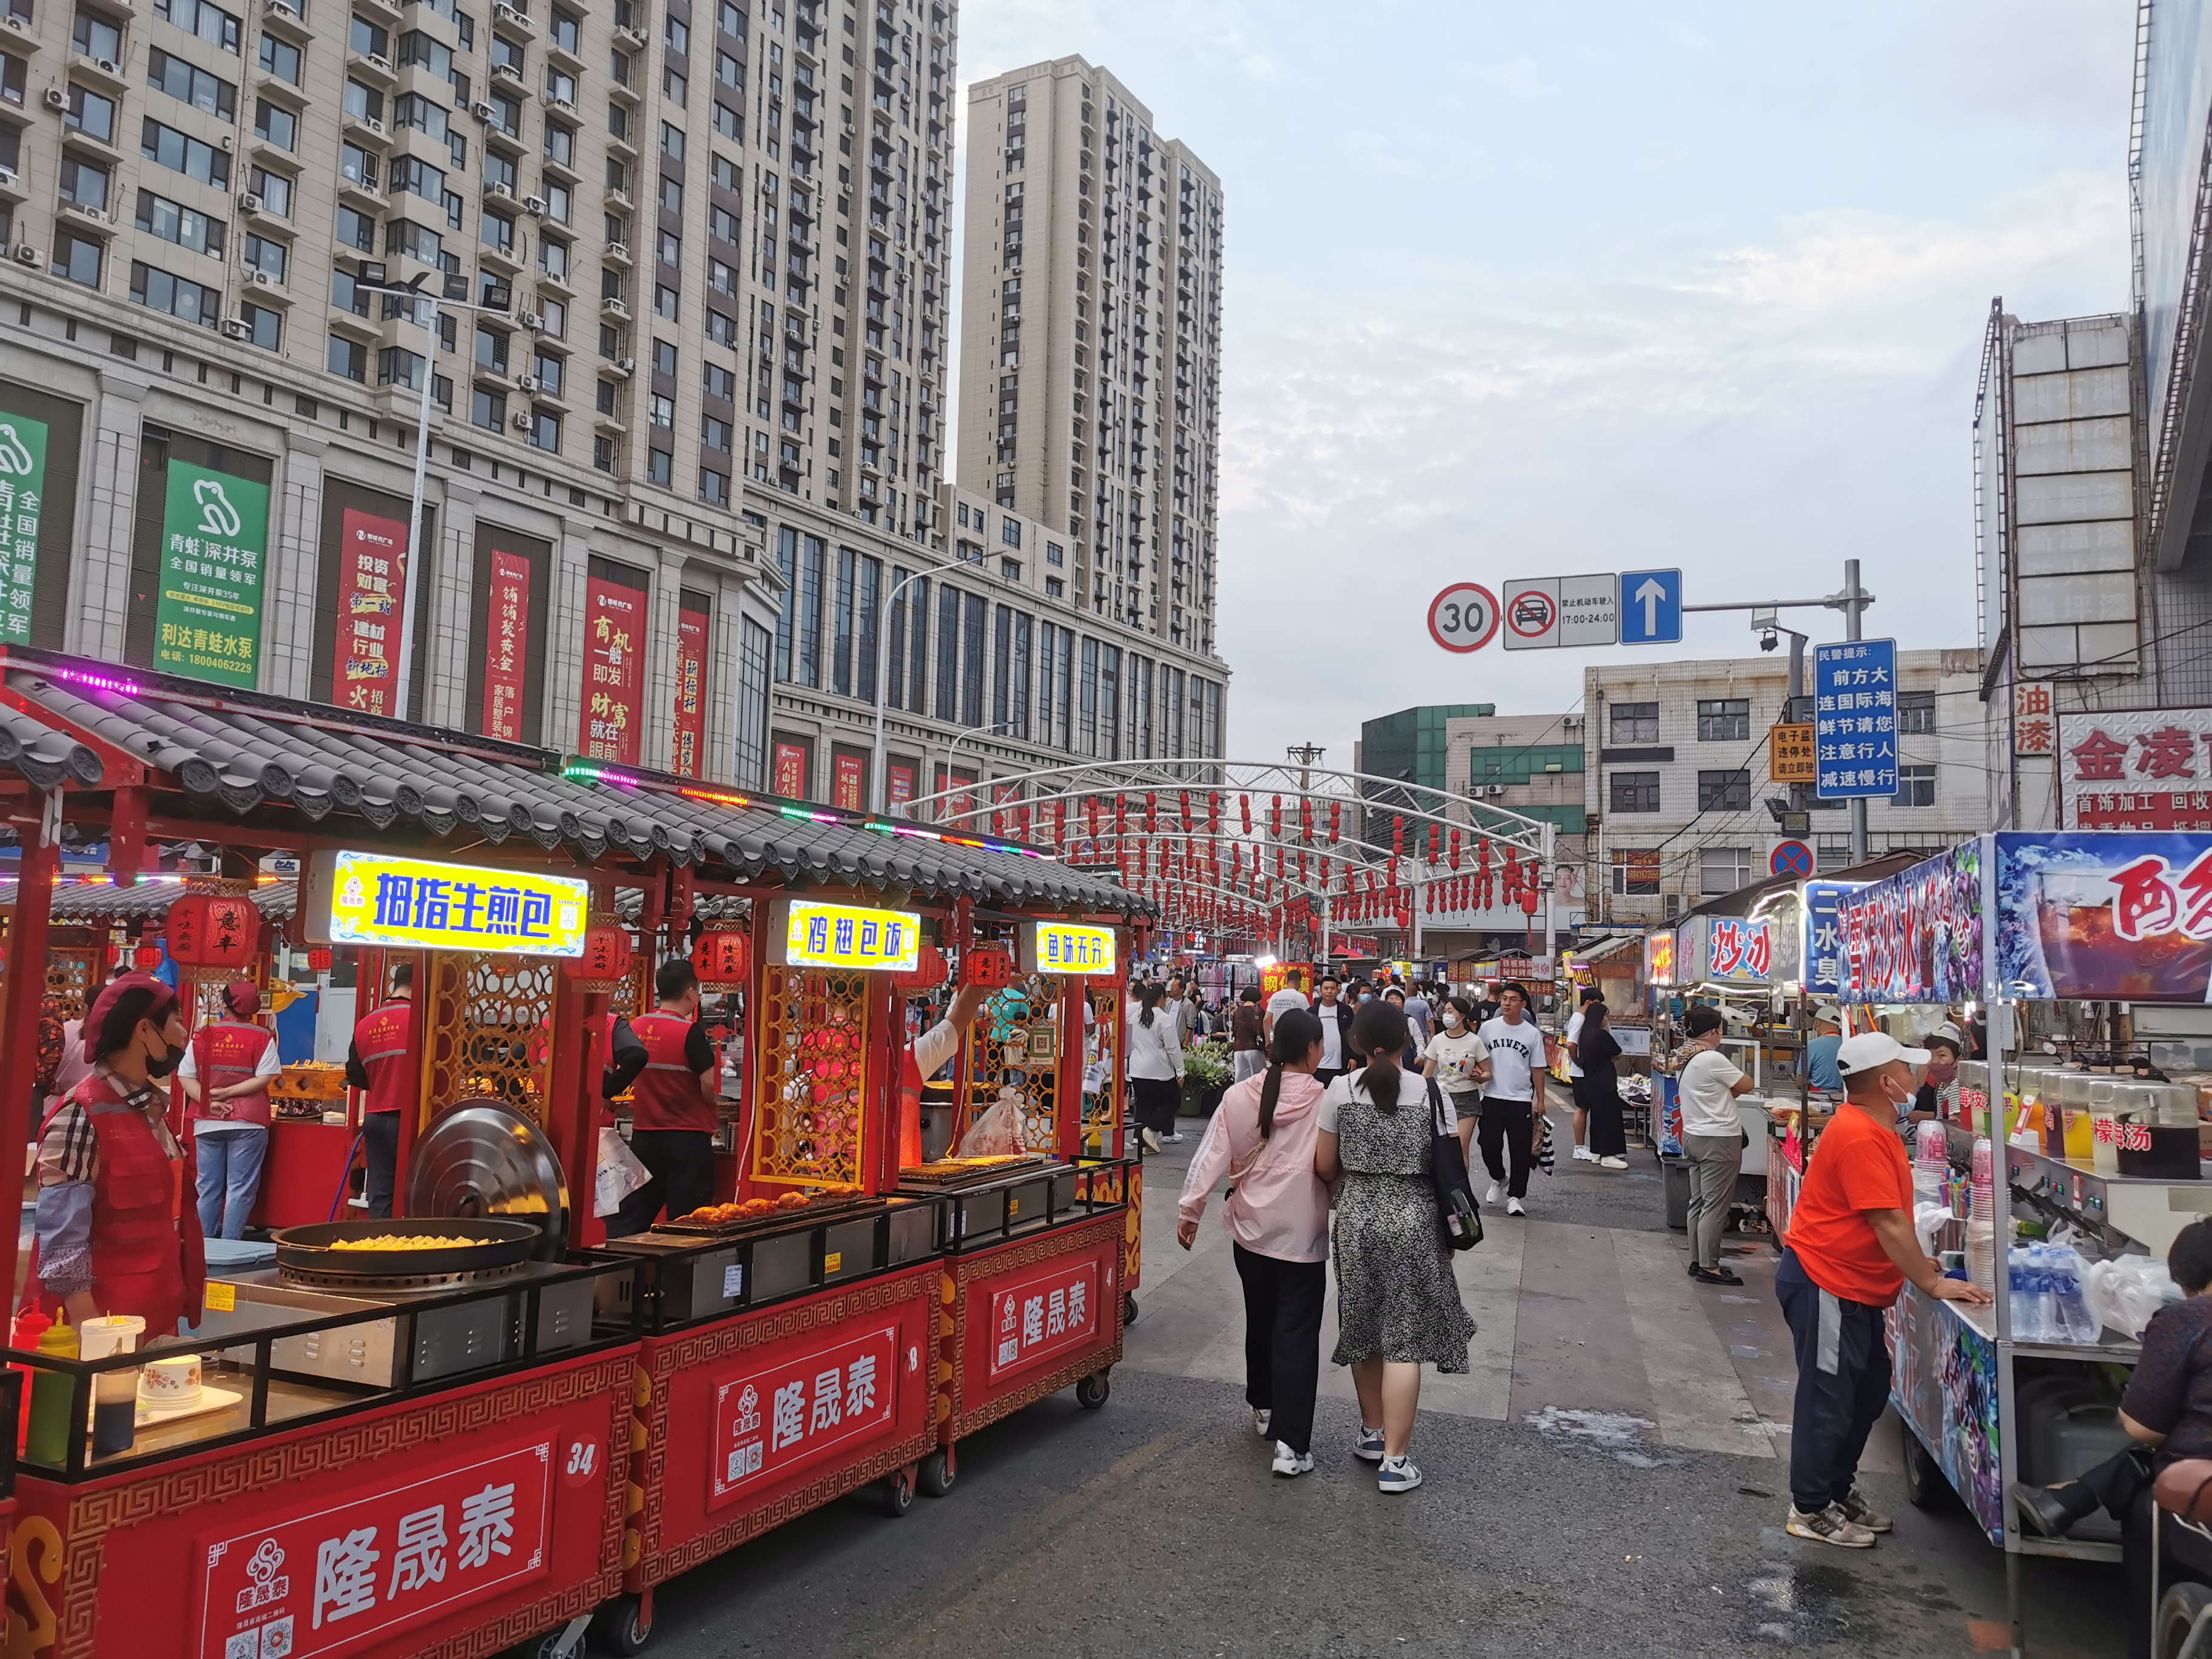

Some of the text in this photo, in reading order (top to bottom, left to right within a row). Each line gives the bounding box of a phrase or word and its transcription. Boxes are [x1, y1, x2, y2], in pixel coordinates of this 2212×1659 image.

[7, 489, 40, 635] 全国销量领军
[170, 556, 256, 586] 全国销量领军
[357, 554, 389, 576] 投资
[183, 581, 240, 600] 专注深井泵35年
[357, 572, 389, 594] 财富
[350, 591, 392, 615] 第一站
[1561, 596, 1615, 608] 禁止机动车驶入
[354, 620, 386, 640] 建材
[498, 585, 519, 673] 铺铺聚黄金
[1443, 602, 1484, 634] 30
[161, 623, 253, 659] 利达青蛙水泵
[593, 615, 633, 653] 商机
[352, 638, 384, 659] 行业
[594, 645, 623, 665] 一触
[189, 654, 252, 674] 18004062229
[345, 655, 389, 679] 新地标
[592, 663, 622, 687] 即发
[1832, 666, 1889, 686] 前方大
[685, 659, 698, 715] 新标杆
[370, 688, 384, 715] 招商
[590, 691, 629, 730] 财富
[1818, 690, 1892, 712] 连国际海
[589, 718, 619, 741] 就在
[1818, 715, 1894, 736] 鲜节请您
[2016, 685, 2053, 752] 油漆
[1778, 730, 1815, 743] 电子监
[588, 740, 618, 762] 眼前
[1820, 741, 1894, 761] 注意行人
[2070, 725, 2212, 780] 金凌
[782, 760, 791, 799] 人山人
[1821, 768, 1895, 788] 减速慢行
[2078, 791, 2211, 814] 首饰加工 回收
[374, 872, 552, 939] 拇指生煎包
[807, 916, 902, 957] 鸡翅包饭
[1047, 933, 1102, 965] 鱼味无穷
[1022, 1279, 1087, 1349] 隆晟泰
[771, 1353, 877, 1453] 隆晟泰
[566, 1441, 596, 1476] 34
[312, 1482, 516, 1631] 隆晟泰
[238, 1577, 288, 1611] 隆晟泰
